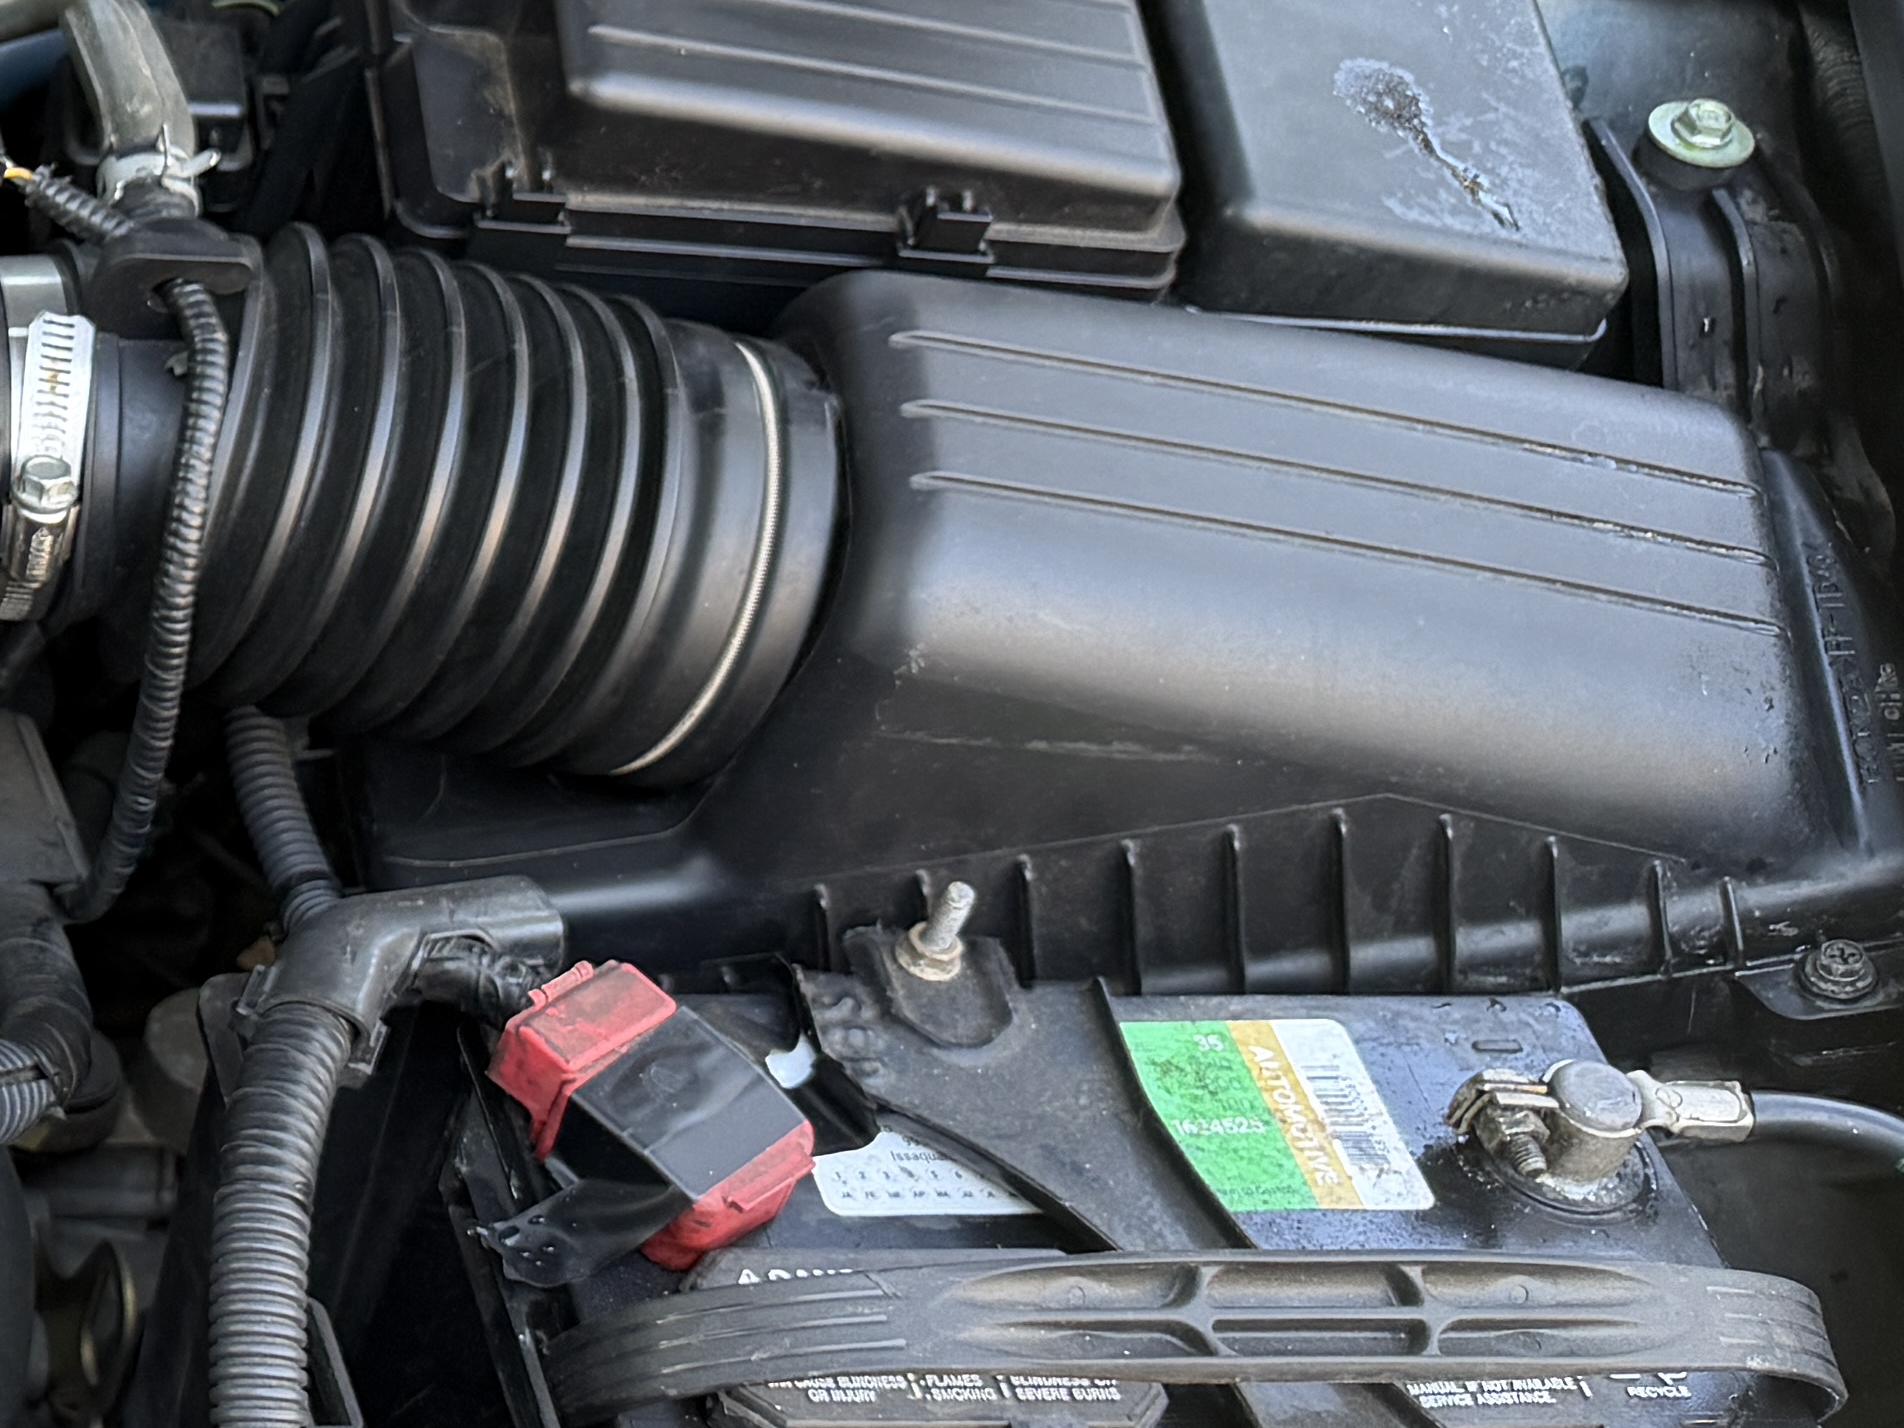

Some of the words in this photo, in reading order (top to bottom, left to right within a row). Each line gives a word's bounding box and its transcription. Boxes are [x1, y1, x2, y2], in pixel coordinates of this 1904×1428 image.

[1193, 1034, 1224, 1052] 35
[831, 1389, 877, 1402] INJURY
[931, 1388, 997, 1402] SMOKING
[1015, 1387, 1070, 1402] SEVERE
[1073, 1388, 1122, 1402] BURNS
[1627, 1385, 1692, 1398] RECYCLE
[1420, 1393, 1474, 1408] SERVICE
